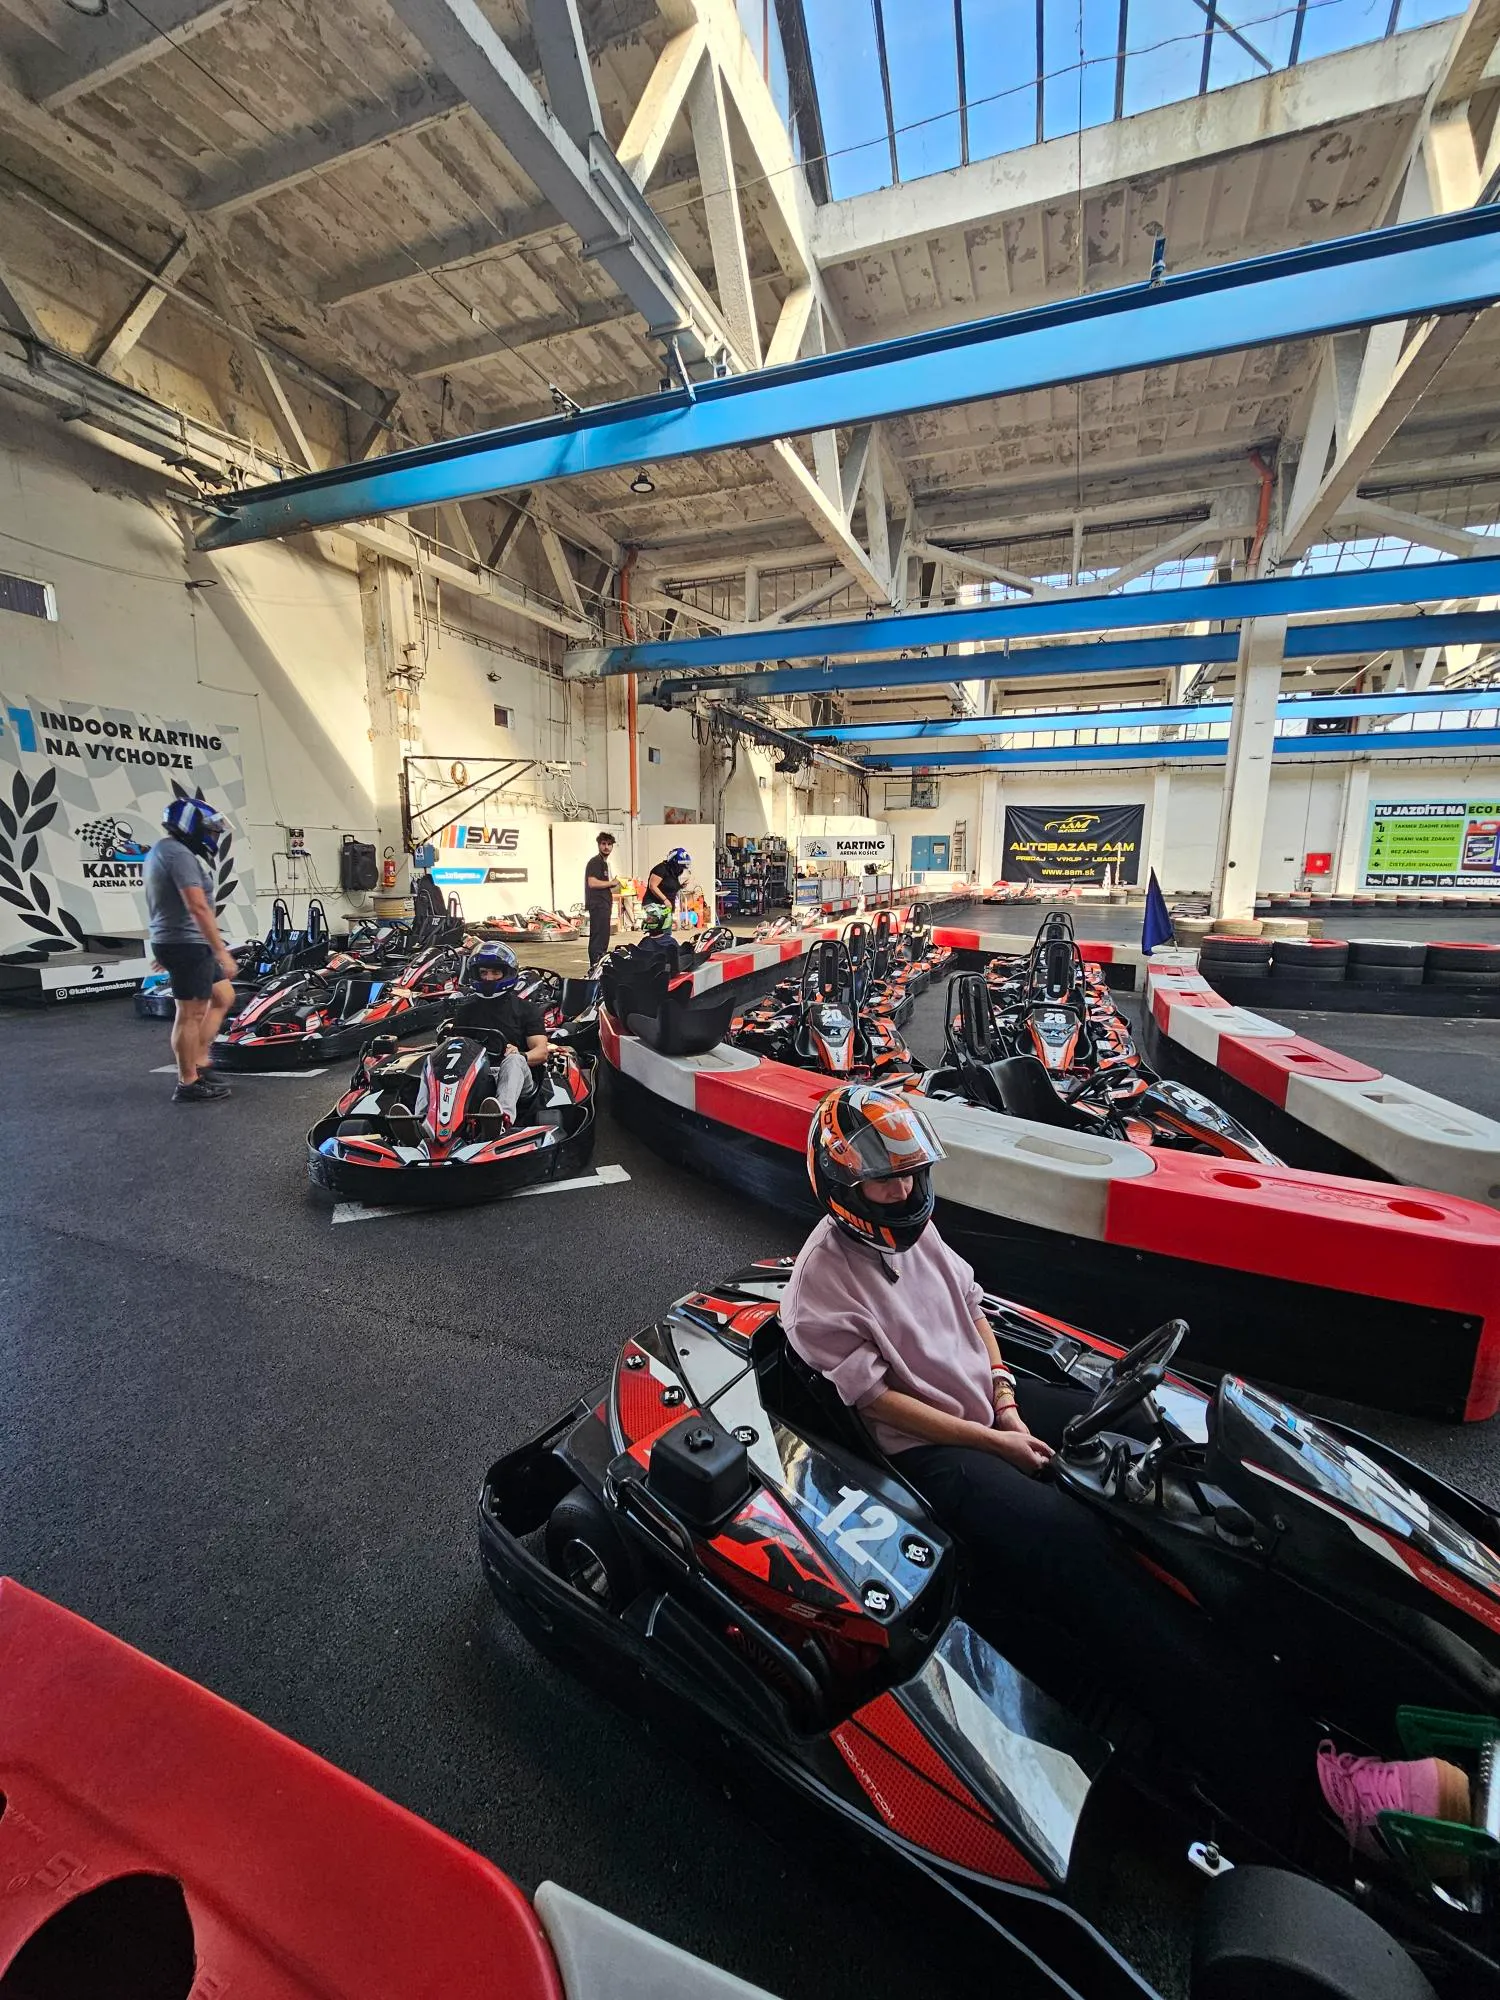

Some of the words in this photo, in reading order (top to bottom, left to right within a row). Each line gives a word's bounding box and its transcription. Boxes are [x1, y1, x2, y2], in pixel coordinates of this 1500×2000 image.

[40, 711, 133, 740] INDOOR
[138, 726, 222, 750] KARTING
[45, 738, 82, 758] NA
[84, 743, 194, 769] VYCHODZE
[1375, 806, 1392, 815] TU
[1392, 805, 1446, 815] JAZDÍTE
[1446, 806, 1464, 815] NA
[1468, 806, 1492, 814] ECO
[836, 841, 886, 850] KARTING
[1009, 841, 1098, 852] AUTOBAZÁR
[1101, 842, 1135, 852] AAM
[1041, 867, 1095, 876] www.aam.sk
[92, 879, 127, 887] ARENA
[91, 965, 104, 979] 2
[1043, 1012, 1066, 1024] 26
[445, 1052, 462, 1070] 7
[819, 1485, 898, 1566] 12
